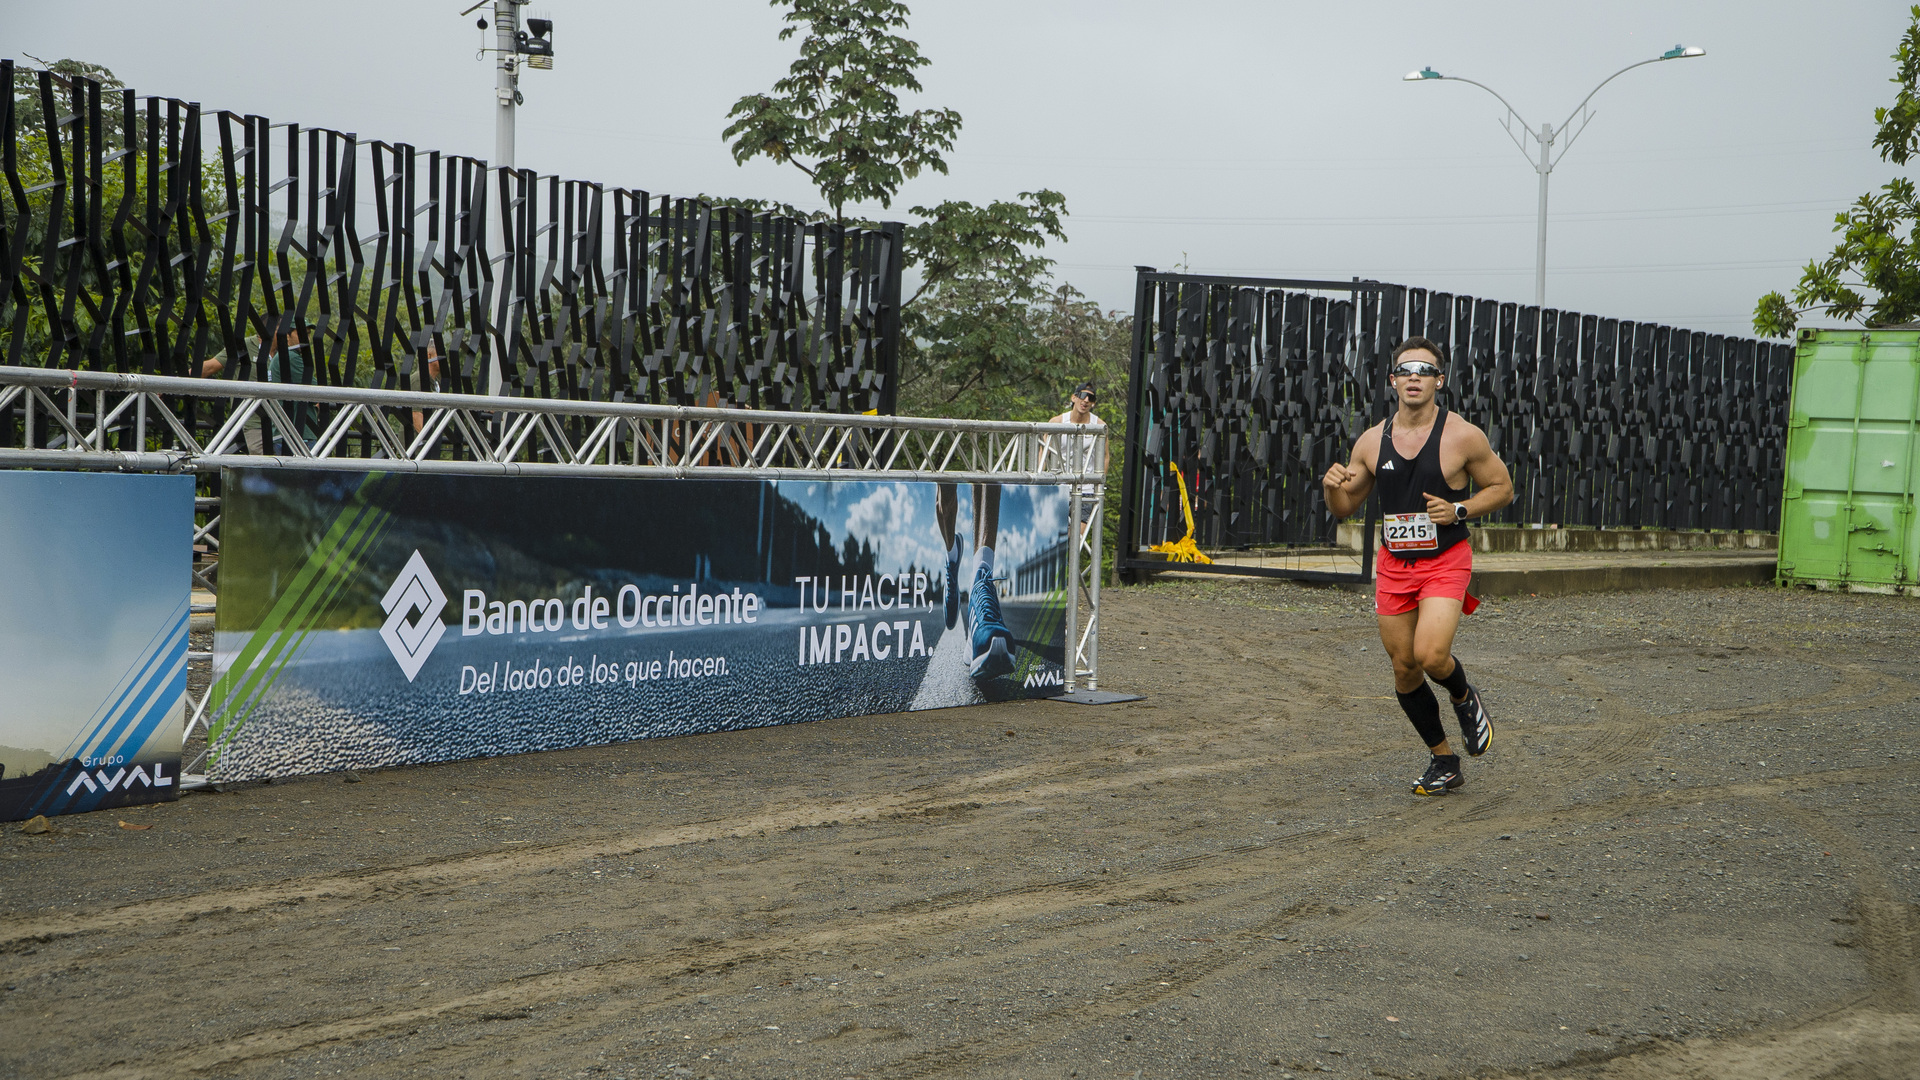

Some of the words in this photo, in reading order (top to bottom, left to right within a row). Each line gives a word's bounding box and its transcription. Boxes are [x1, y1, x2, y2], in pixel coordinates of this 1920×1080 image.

[1388, 525, 1427, 539] 2215
[462, 589, 564, 636] Banco
[572, 585, 610, 630] de
[617, 583, 758, 629] Occidente
[795, 575, 830, 614] TU
[841, 572, 934, 614] HACER,
[799, 620, 934, 666] IMPACTA.
[459, 661, 499, 695] Del
[503, 658, 552, 692] lado
[557, 656, 584, 687] de
[590, 654, 619, 684] los
[625, 659, 662, 688] que
[667, 650, 730, 680] hacen.
[1023, 669, 1064, 689] AVAL
[66, 763, 173, 797] AVAL
[82, 755, 124, 768] Grupo
